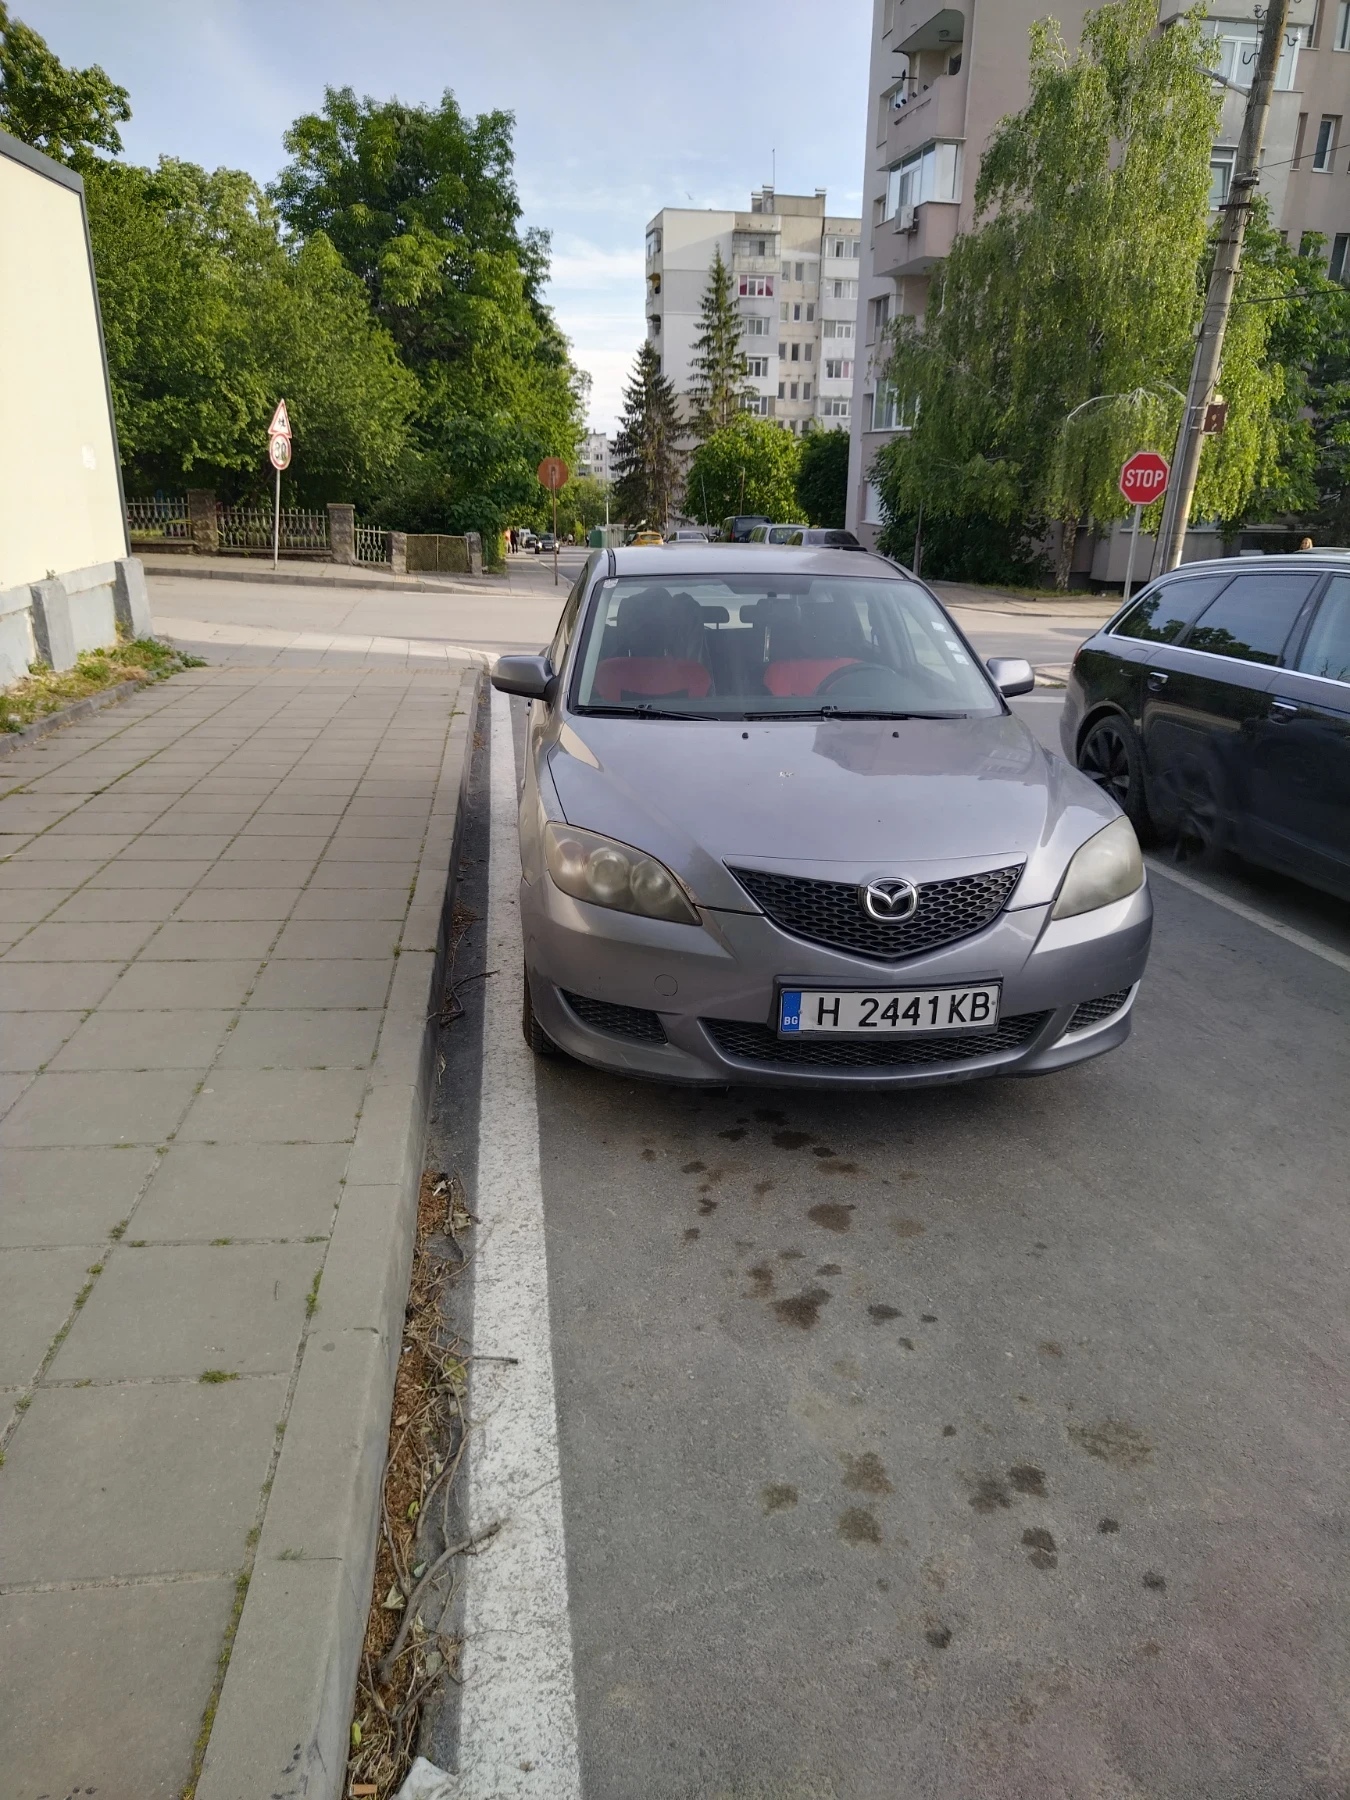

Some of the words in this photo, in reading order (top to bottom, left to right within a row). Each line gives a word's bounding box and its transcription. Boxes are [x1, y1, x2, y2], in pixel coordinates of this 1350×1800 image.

[275, 441, 287, 460] 30
[1125, 469, 1164, 488] STOP
[784, 1016, 798, 1025] BG
[817, 997, 840, 1026] H
